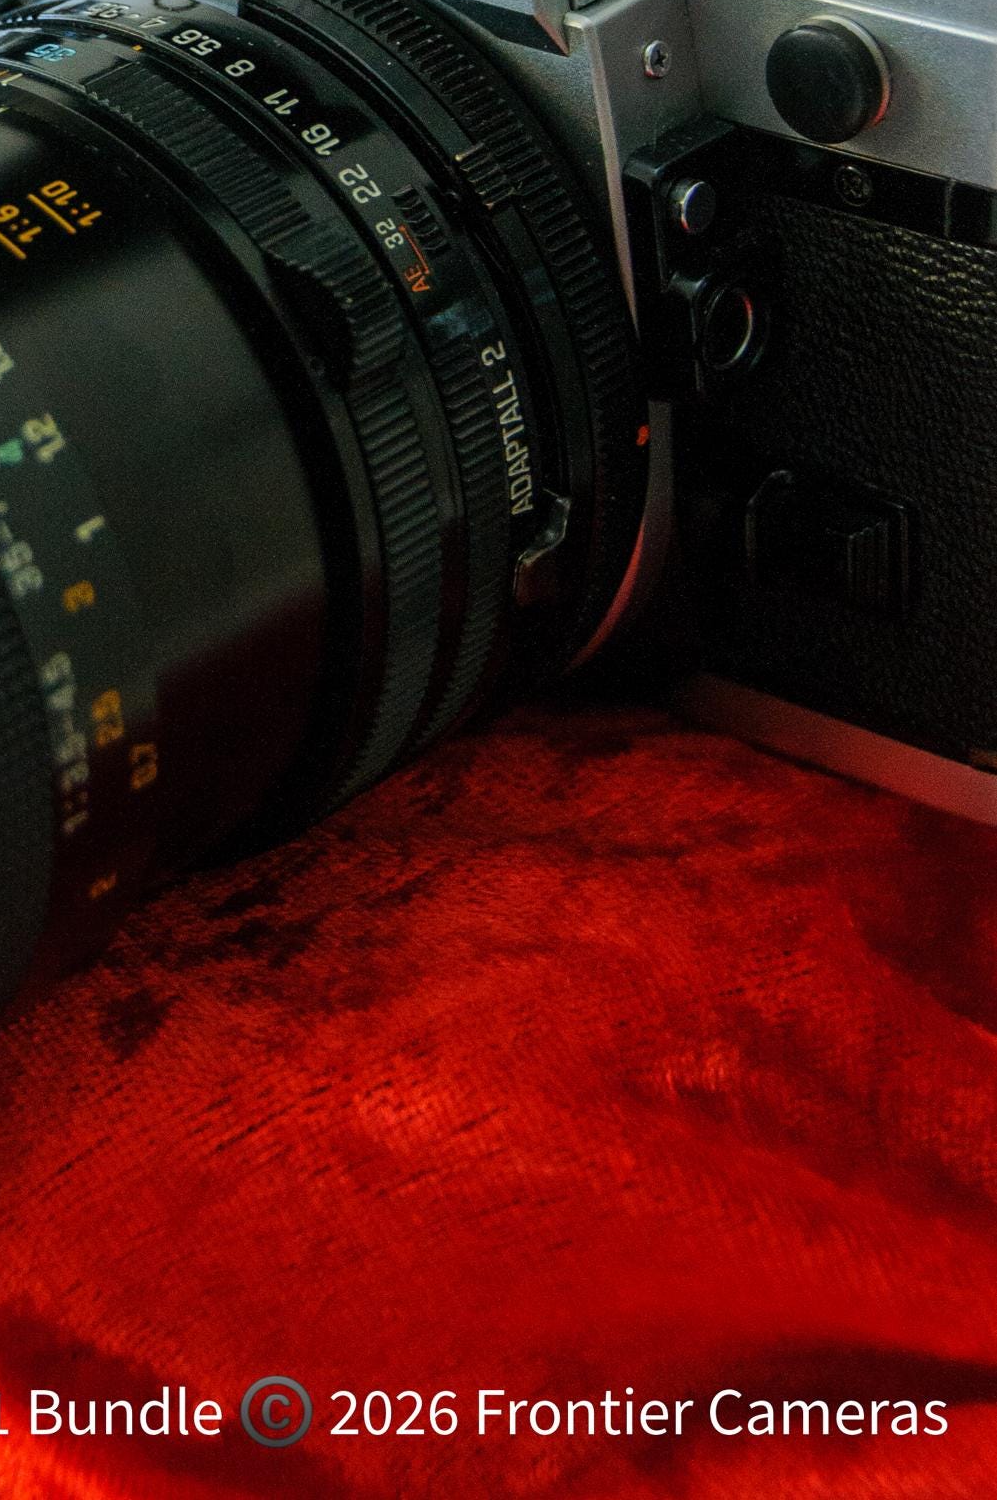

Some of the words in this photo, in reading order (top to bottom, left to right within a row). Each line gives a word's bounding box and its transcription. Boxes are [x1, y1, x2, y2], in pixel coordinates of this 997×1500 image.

[138, 15, 167, 29] 4
[172, 29, 222, 57] 5.6
[224, 58, 256, 79] 8
[263, 88, 300, 117] 11
[302, 123, 340, 157] 16
[339, 163, 381, 206] 22
[40, 180, 102, 228] 1:10
[375, 217, 405, 249] 32
[404, 263, 430, 293] AE
[481, 339, 506, 368] 2
[492, 370, 534, 515] ADAPTALL
